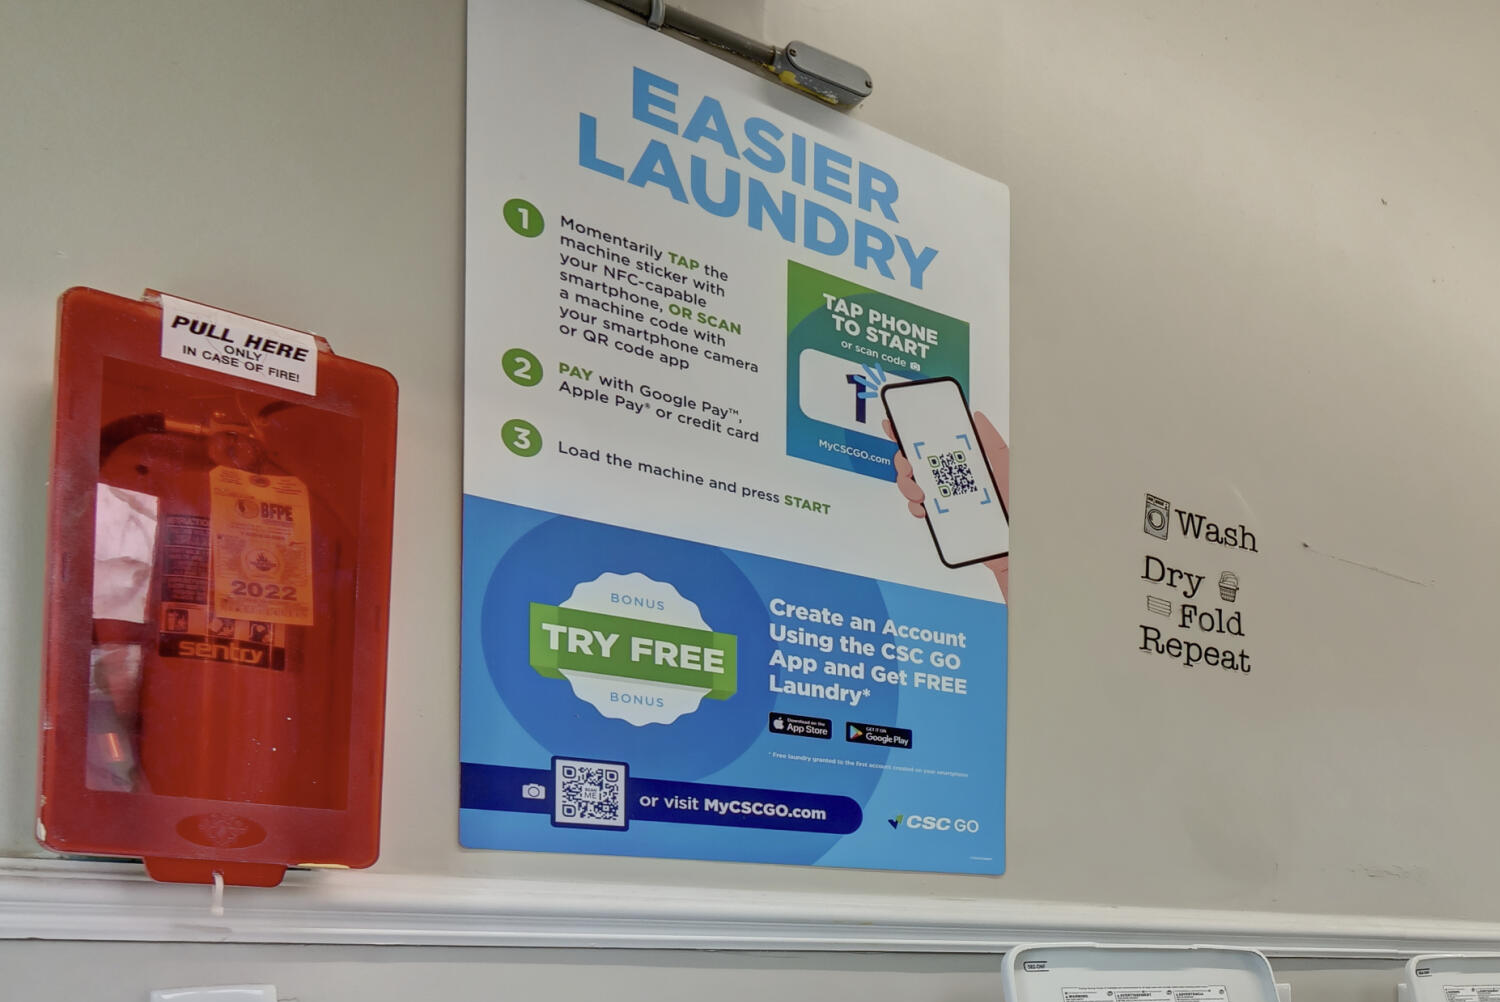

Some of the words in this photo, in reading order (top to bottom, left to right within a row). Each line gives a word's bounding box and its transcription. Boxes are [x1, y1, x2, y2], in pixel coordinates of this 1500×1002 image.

[633, 65, 900, 223] EASIER
[517, 207, 530, 230] 1
[579, 111, 939, 290] LAUNDRY
[560, 235, 630, 266] machine
[636, 259, 688, 285] sticker
[693, 278, 725, 297] with
[561, 215, 662, 261] Momentarily
[668, 251, 700, 270] TAP
[704, 264, 728, 282] the
[560, 253, 597, 273] your
[604, 266, 707, 308] NFC-capable
[560, 271, 663, 312] smartphone,
[668, 303, 692, 320] OR
[697, 312, 741, 335] SCAN
[560, 289, 569, 299] a
[576, 293, 644, 322] machine
[650, 316, 688, 335] code
[694, 329, 726, 347] with
[823, 293, 863, 318] TAP
[869, 309, 938, 345] PHONE
[171, 315, 234, 343] PULL
[244, 334, 309, 362] HERE
[224, 345, 262, 361] ONLY
[560, 306, 597, 325] your
[603, 319, 699, 355] smartphone
[704, 350, 758, 373] camera
[560, 325, 577, 337] or
[583, 330, 609, 346] QR
[615, 340, 654, 359] code
[659, 355, 690, 370] app
[832, 314, 860, 336] TO
[866, 326, 930, 358] START
[841, 341, 851, 349] or
[856, 346, 878, 358] scan
[882, 352, 906, 367] code
[183, 345, 196, 356] IN
[202, 350, 239, 368] CASE
[244, 361, 264, 372] OF
[268, 367, 300, 382] FIRE!
[513, 357, 532, 380] 2
[559, 362, 593, 381] PAY
[599, 375, 633, 394] with
[640, 384, 696, 409] Google
[846, 374, 866, 424] 1
[559, 381, 609, 404] Apple
[656, 407, 672, 420] or
[678, 413, 721, 433] credit
[727, 425, 759, 442] card
[513, 426, 531, 449] 3
[819, 439, 890, 465] MyCSCGO.com
[558, 441, 600, 462] Load
[606, 452, 632, 469] the
[638, 461, 704, 486] machine
[709, 477, 736, 493] and
[742, 486, 780, 504] press
[784, 494, 831, 515] START
[260, 502, 293, 521] BFPE
[1174, 509, 1258, 552] Wash
[231, 580, 297, 600] 2022
[1141, 555, 1205, 598] Dry
[610, 593, 665, 610] BONUS
[769, 598, 844, 627] Create
[850, 616, 875, 633] an
[882, 619, 966, 648] Account
[1178, 604, 1245, 636] Fold
[179, 640, 263, 664] sentry
[542, 622, 620, 658] TRY
[631, 636, 724, 674] FREE
[769, 623, 834, 653] Using
[840, 636, 875, 656] the
[881, 643, 923, 664] CSC
[929, 651, 961, 670] GO
[1139, 625, 1251, 673] Repeat
[769, 650, 817, 674] App
[824, 661, 864, 679] and
[871, 666, 907, 686] Get
[914, 672, 967, 695] FREE
[610, 691, 664, 707] BONUS
[787, 724, 804, 735] App
[806, 726, 828, 736] Store
[866, 733, 893, 744] Google
[894, 736, 909, 746] Play
[788, 754, 811, 762] laundry
[584, 791, 597, 799] ME
[640, 796, 659, 807] or
[664, 795, 699, 810] visit
[704, 798, 827, 820] MyCSCGO.com
[906, 815, 950, 831] CSC
[954, 819, 980, 833] GO
